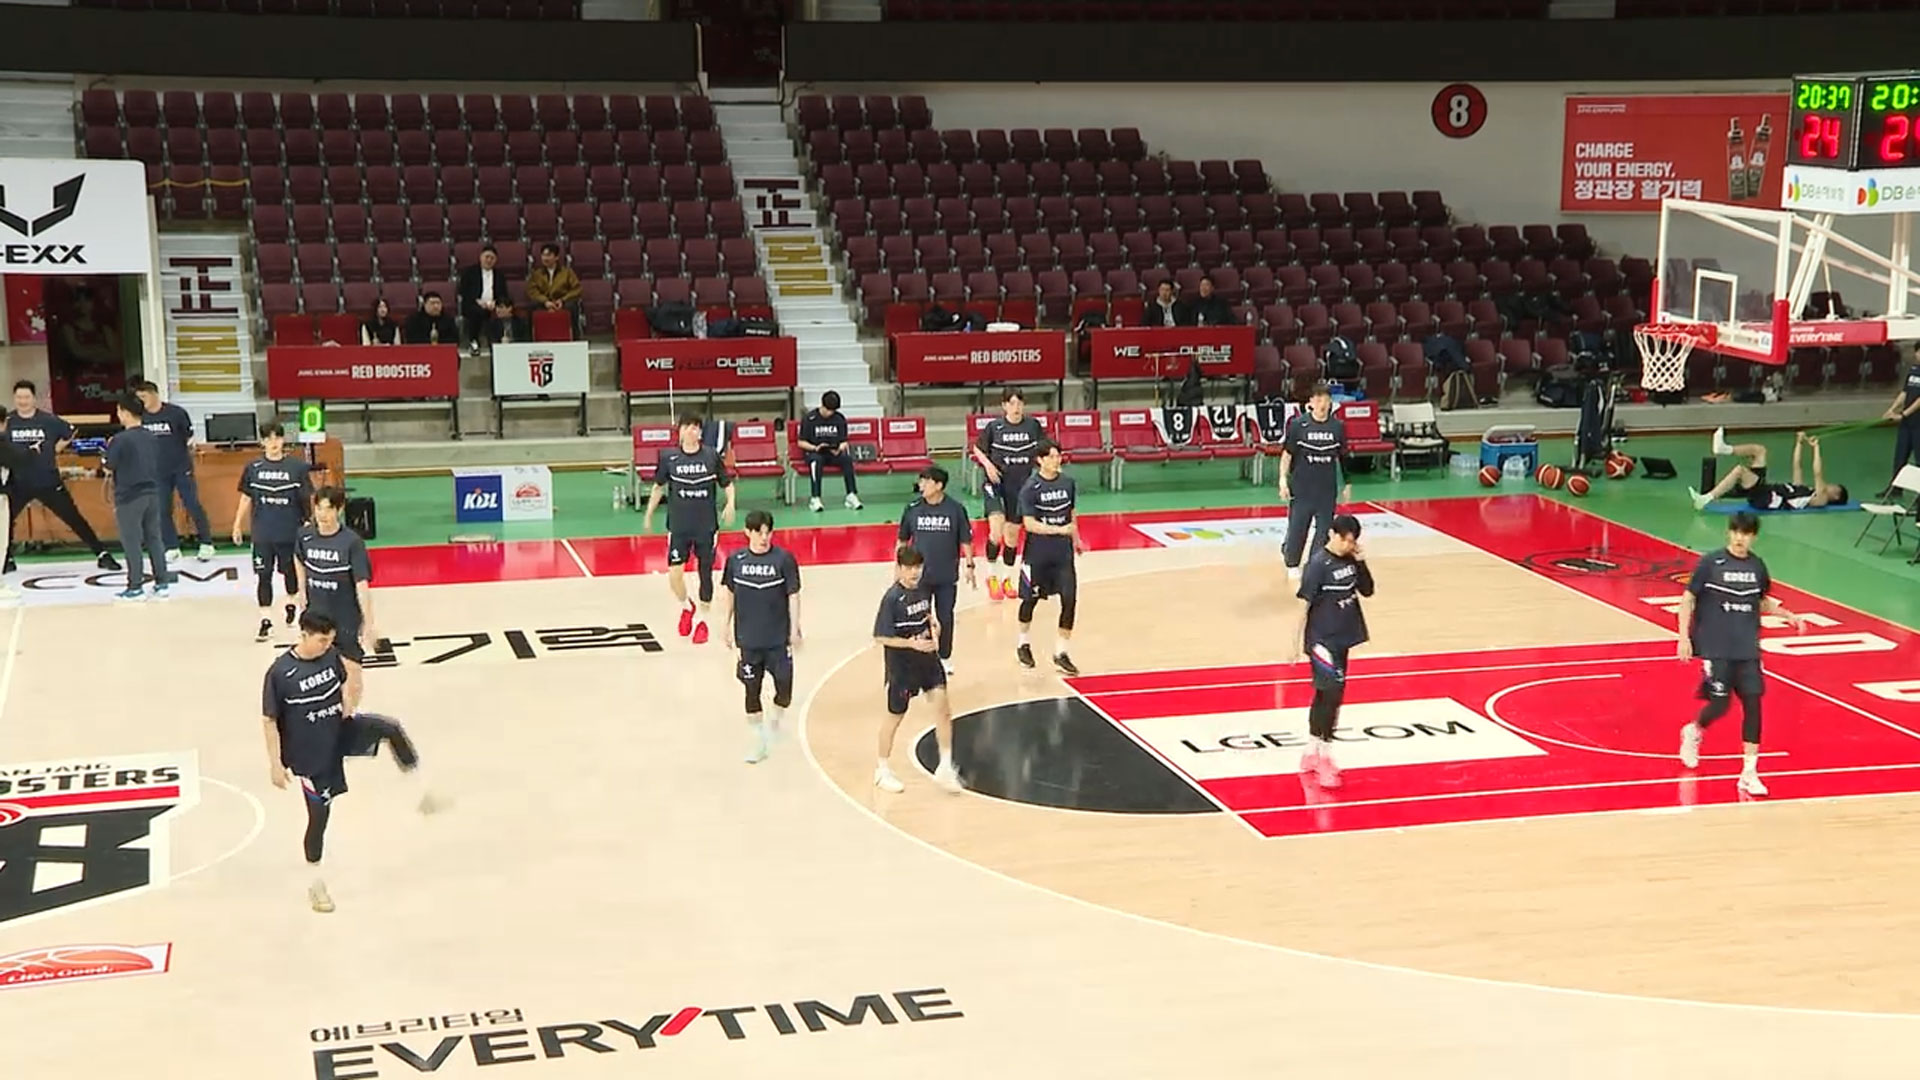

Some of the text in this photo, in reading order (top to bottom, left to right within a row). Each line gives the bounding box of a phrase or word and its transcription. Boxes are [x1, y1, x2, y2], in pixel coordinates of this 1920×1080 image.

[1798, 84, 1850, 109] 20:37
[1446, 94, 1470, 129] 8
[1801, 114, 1841, 158] 24
[1576, 142, 1634, 158] CHARGE
[1575, 162, 1676, 178] YOUR ENERGY,
[1575, 180, 1702, 200] 정관장 활기력
[0, 244, 87, 264] EXX
[970, 351, 990, 364] RED
[991, 349, 1041, 363] BOOSTERS
[1114, 346, 1140, 356] WE
[351, 364, 374, 379] RED
[375, 363, 431, 378] BOOSTERS
[645, 357, 674, 369] WE
[303, 406, 322, 432] 0
[1171, 412, 1182, 431] 8
[1212, 405, 1232, 425] 12
[11, 428, 45, 438] KOREA
[1003, 432, 1030, 442] KOREA
[1307, 431, 1334, 441] KOREA
[258, 470, 290, 480] KOREA
[674, 464, 707, 474] KOREA
[463, 492, 498, 510] KBL
[1040, 491, 1069, 503] KOREA
[917, 515, 950, 527] KOREA
[306, 548, 340, 563] KOREA
[742, 564, 775, 576] KOREA
[1722, 571, 1757, 583] KOREA
[299, 667, 335, 692] KOREA
[1180, 719, 1476, 754] LGECOM
[310, 1008, 524, 1043] 에브리타임
